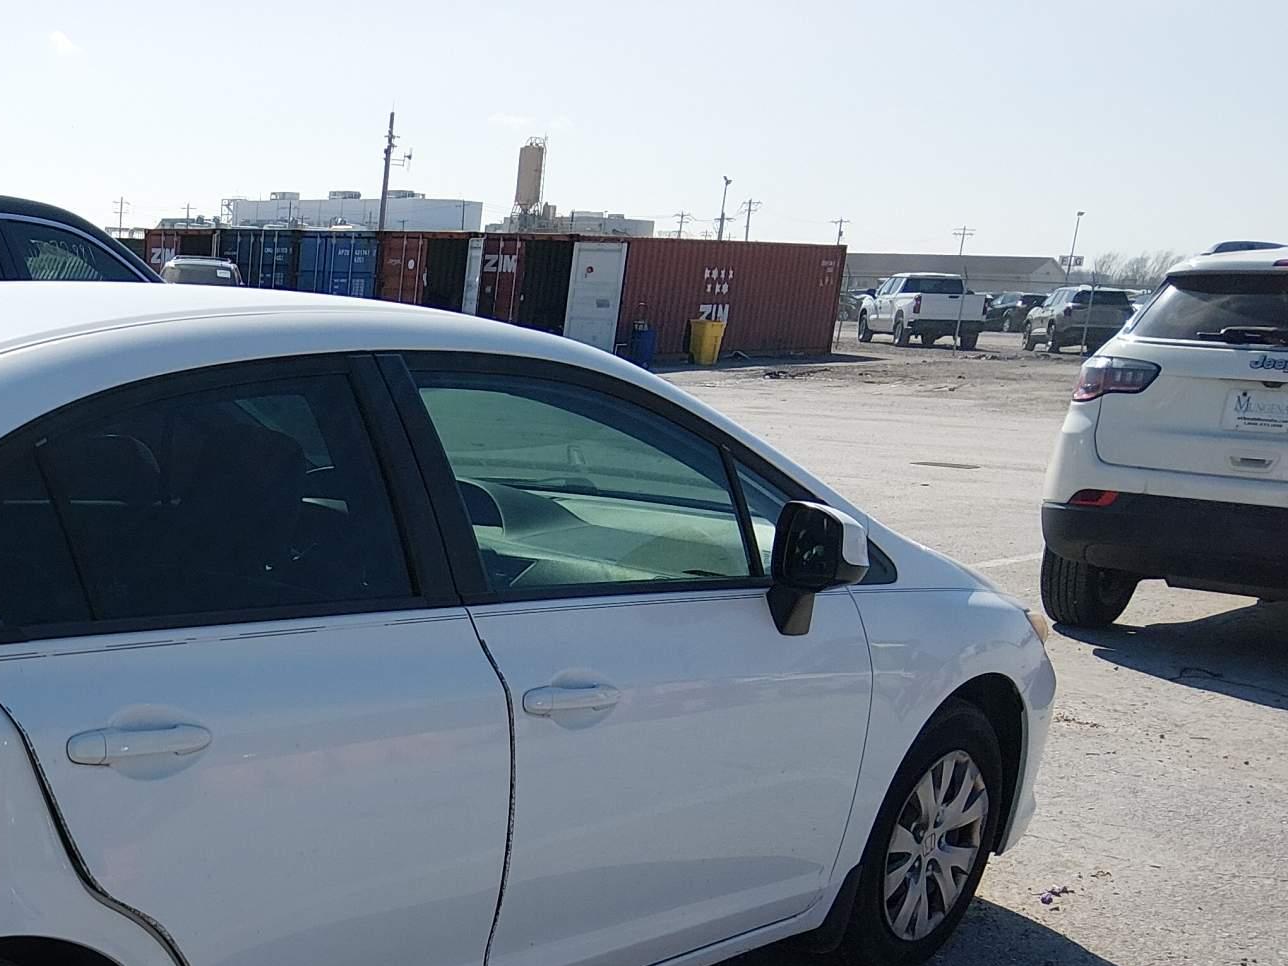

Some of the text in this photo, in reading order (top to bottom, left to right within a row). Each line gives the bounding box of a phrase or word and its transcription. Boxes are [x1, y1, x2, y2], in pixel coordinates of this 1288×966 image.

[151, 247, 176, 264] ZIM
[483, 254, 518, 273] ZIM
[699, 303, 730, 325] ZIM
